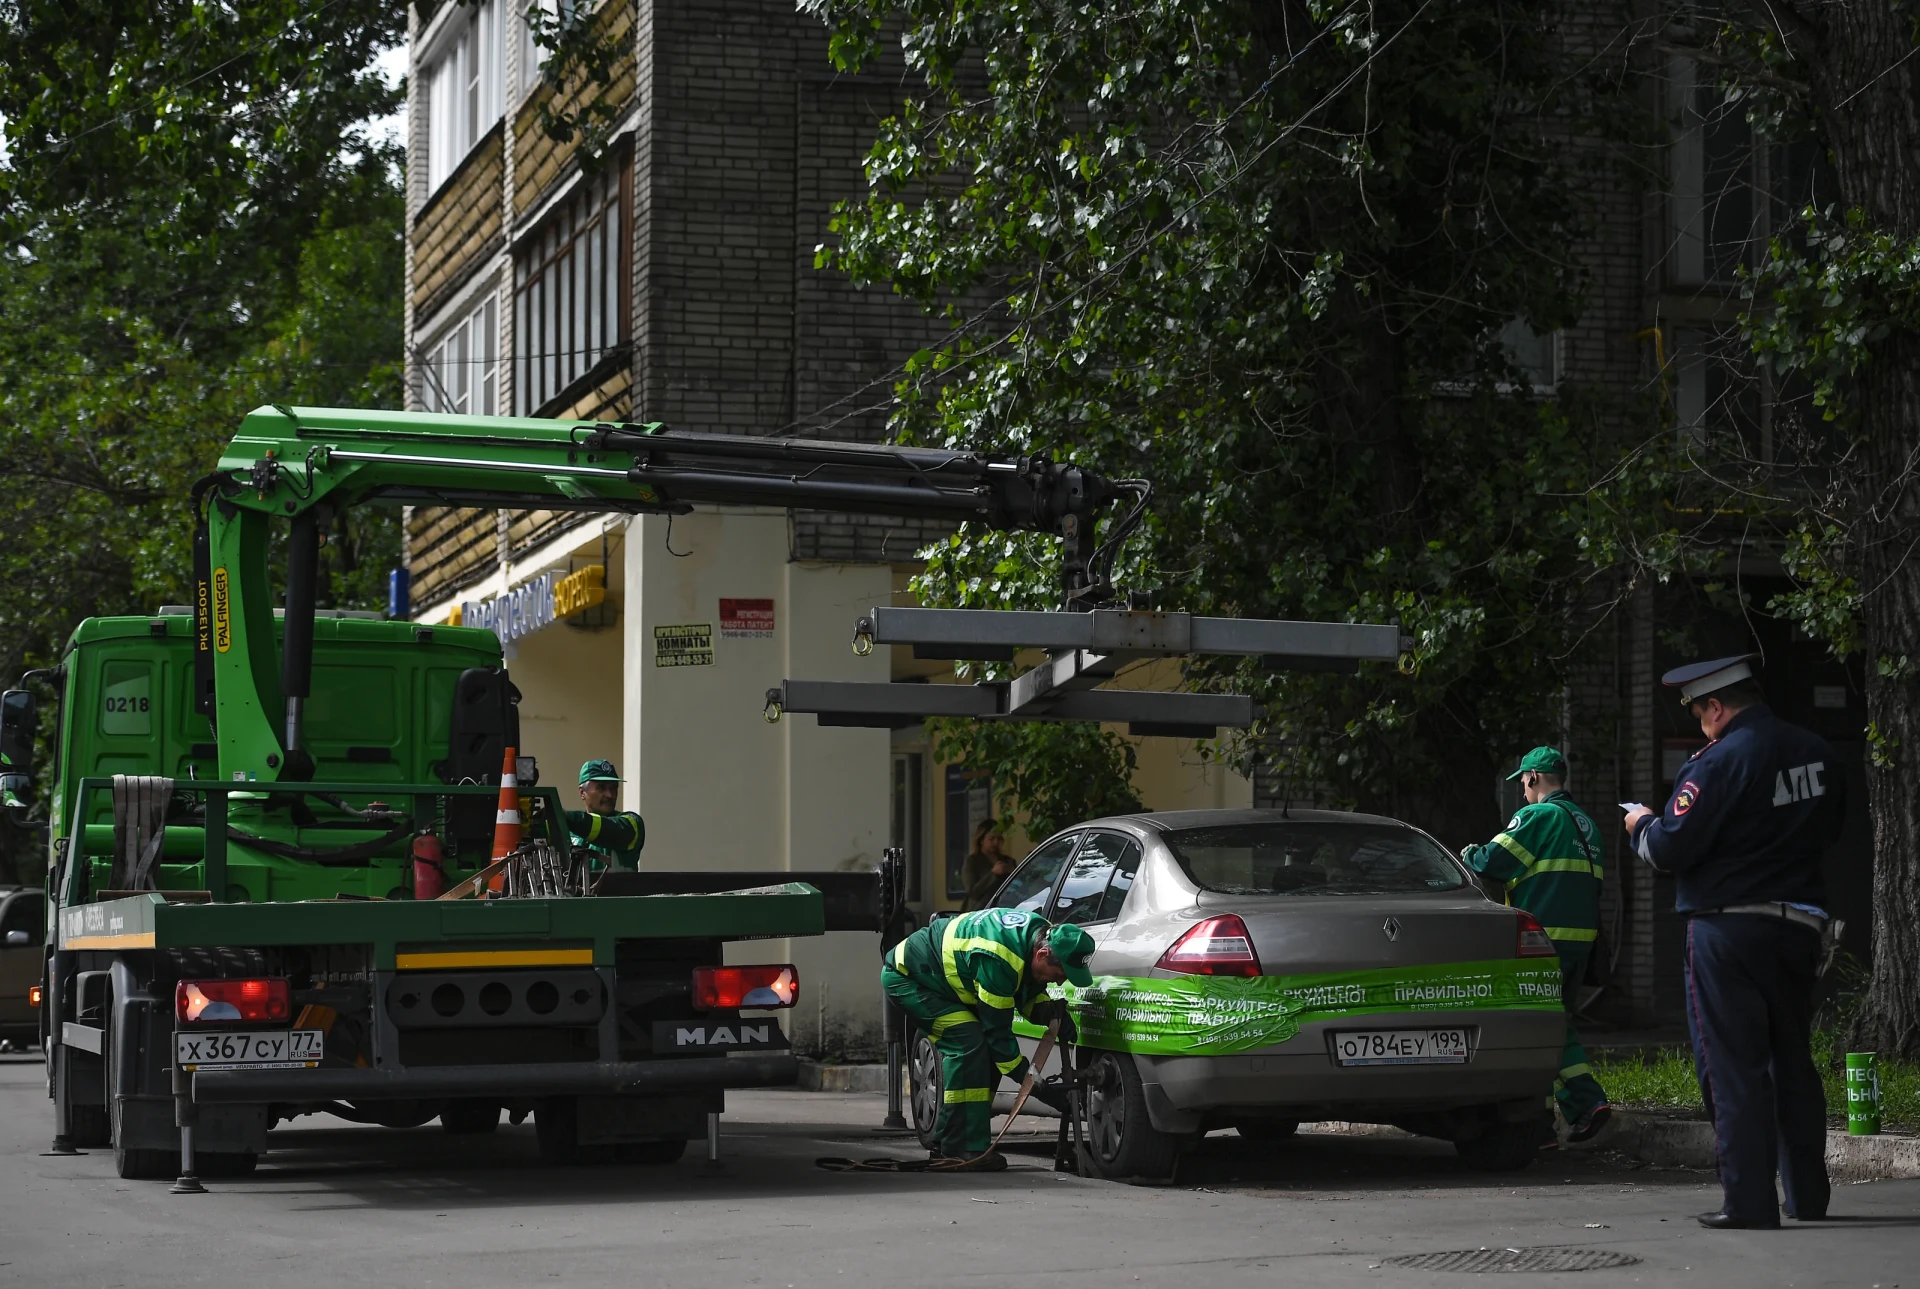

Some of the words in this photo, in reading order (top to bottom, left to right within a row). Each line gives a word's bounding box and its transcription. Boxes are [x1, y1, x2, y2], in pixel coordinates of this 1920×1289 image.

[198, 580, 208, 631] 13500T
[215, 573, 229, 647] PALFINGER
[746, 621, 773, 629] ПАТЕНТ
[199, 632, 209, 651] PK
[657, 637, 710, 650] КОМНАТЫ
[106, 697, 149, 713] 0218
[1773, 761, 1826, 807] ДПС
[1119, 989, 1173, 1006] ПАРКУЙТЕСЬ
[1395, 984, 1493, 1001] ПРАВИЛЬНО!
[1519, 983, 1562, 997] ПРАВИ
[1115, 1007, 1171, 1024] ПРАВИЛЬНО!
[292, 1033, 315, 1051] 77
[677, 1025, 769, 1046] MAN
[1224, 1033, 1238, 1041] 539
[1241, 1031, 1251, 1039] 54
[1253, 1029, 1263, 1037] 54
[1431, 1031, 1460, 1049] 199
[1438, 1048, 1453, 1056] RUS
[1846, 1067, 1877, 1082] ТЕС
[1857, 1113, 1867, 1122] 54
